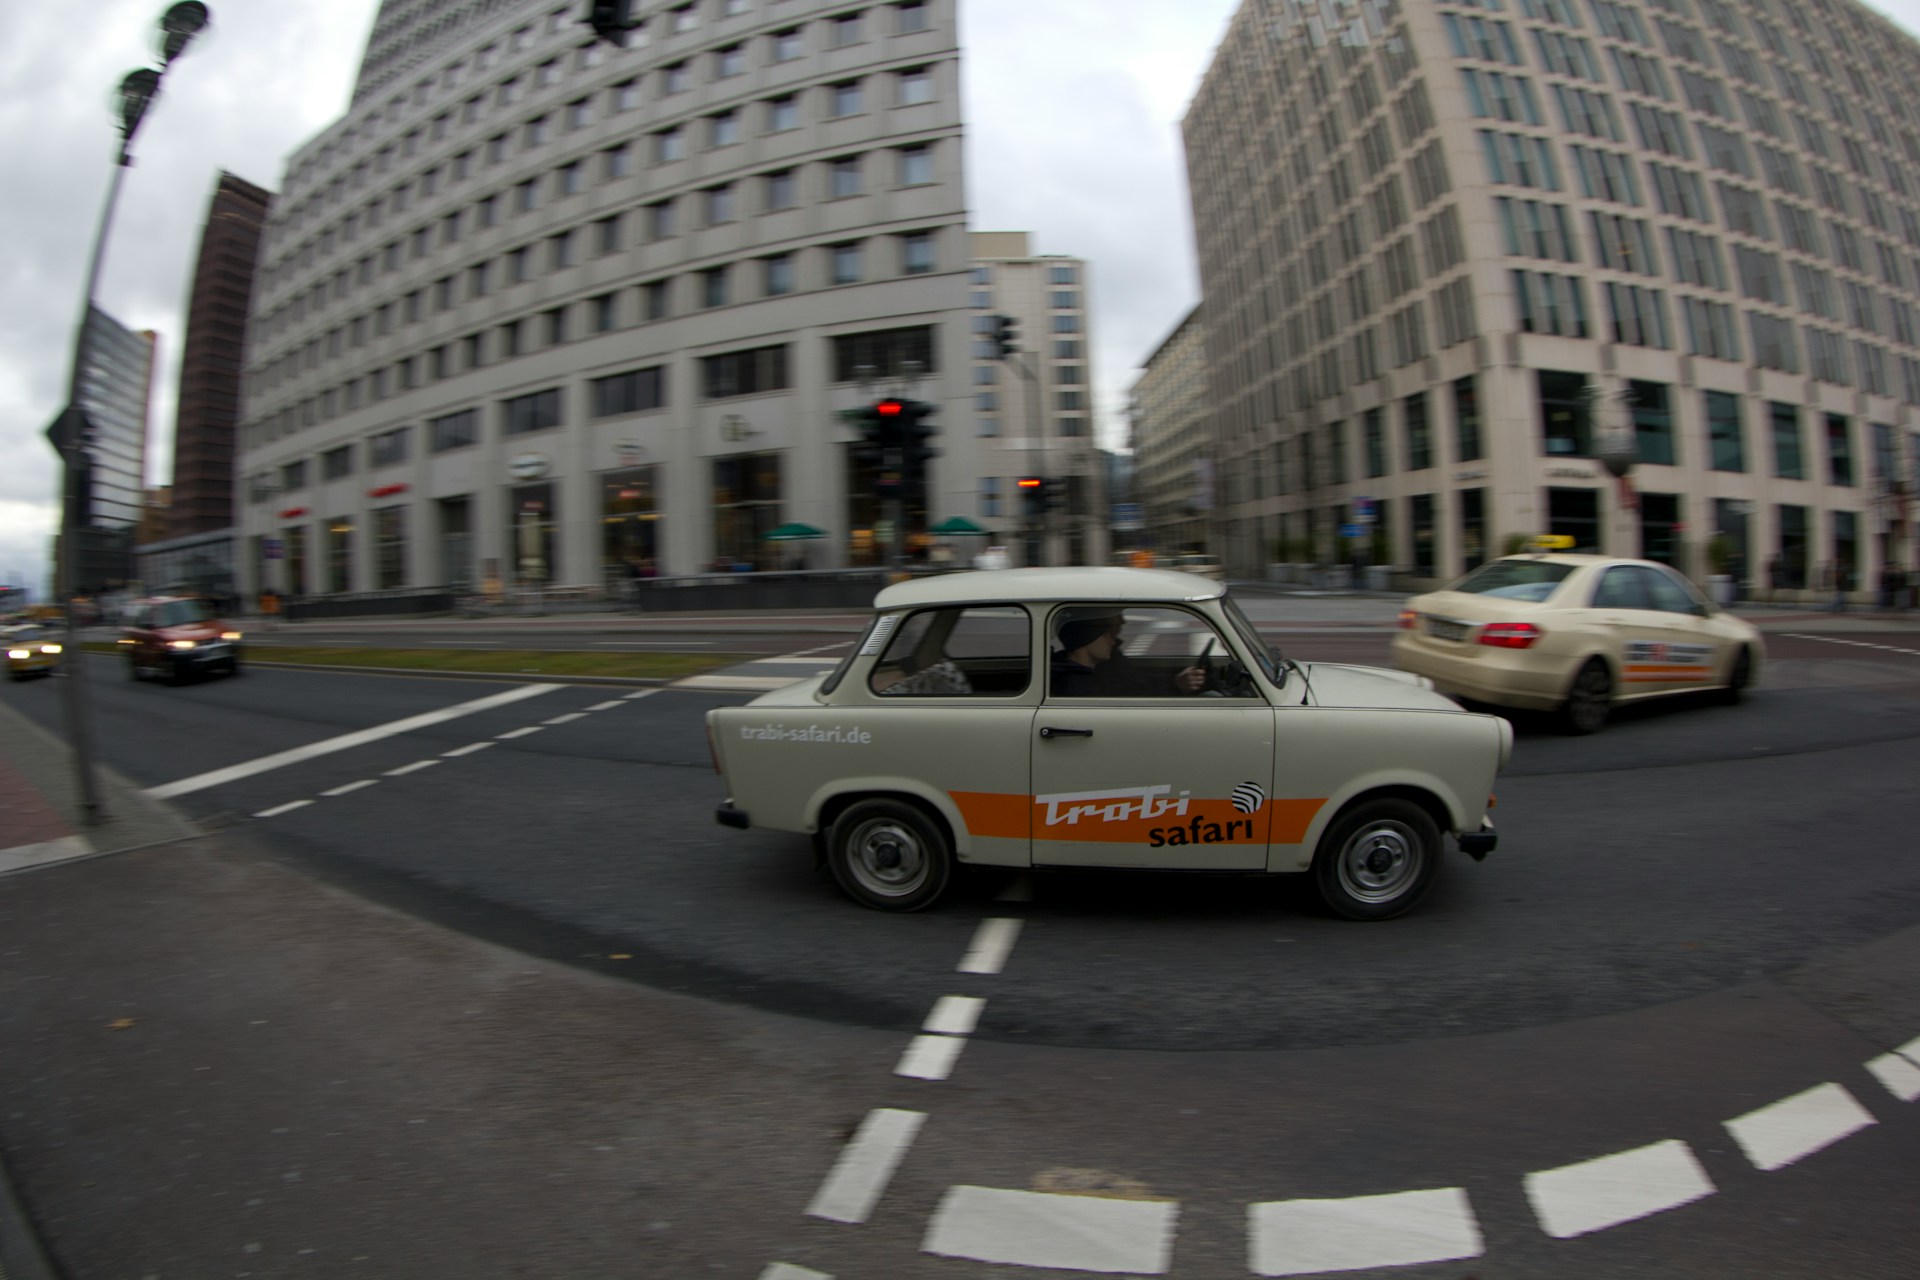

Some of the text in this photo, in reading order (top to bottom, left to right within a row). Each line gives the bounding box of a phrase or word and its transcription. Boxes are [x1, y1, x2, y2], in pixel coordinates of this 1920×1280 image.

[740, 723, 872, 744] trabi-safari.de
[1035, 784, 1190, 825] Trabi
[1149, 815, 1253, 848] safari
